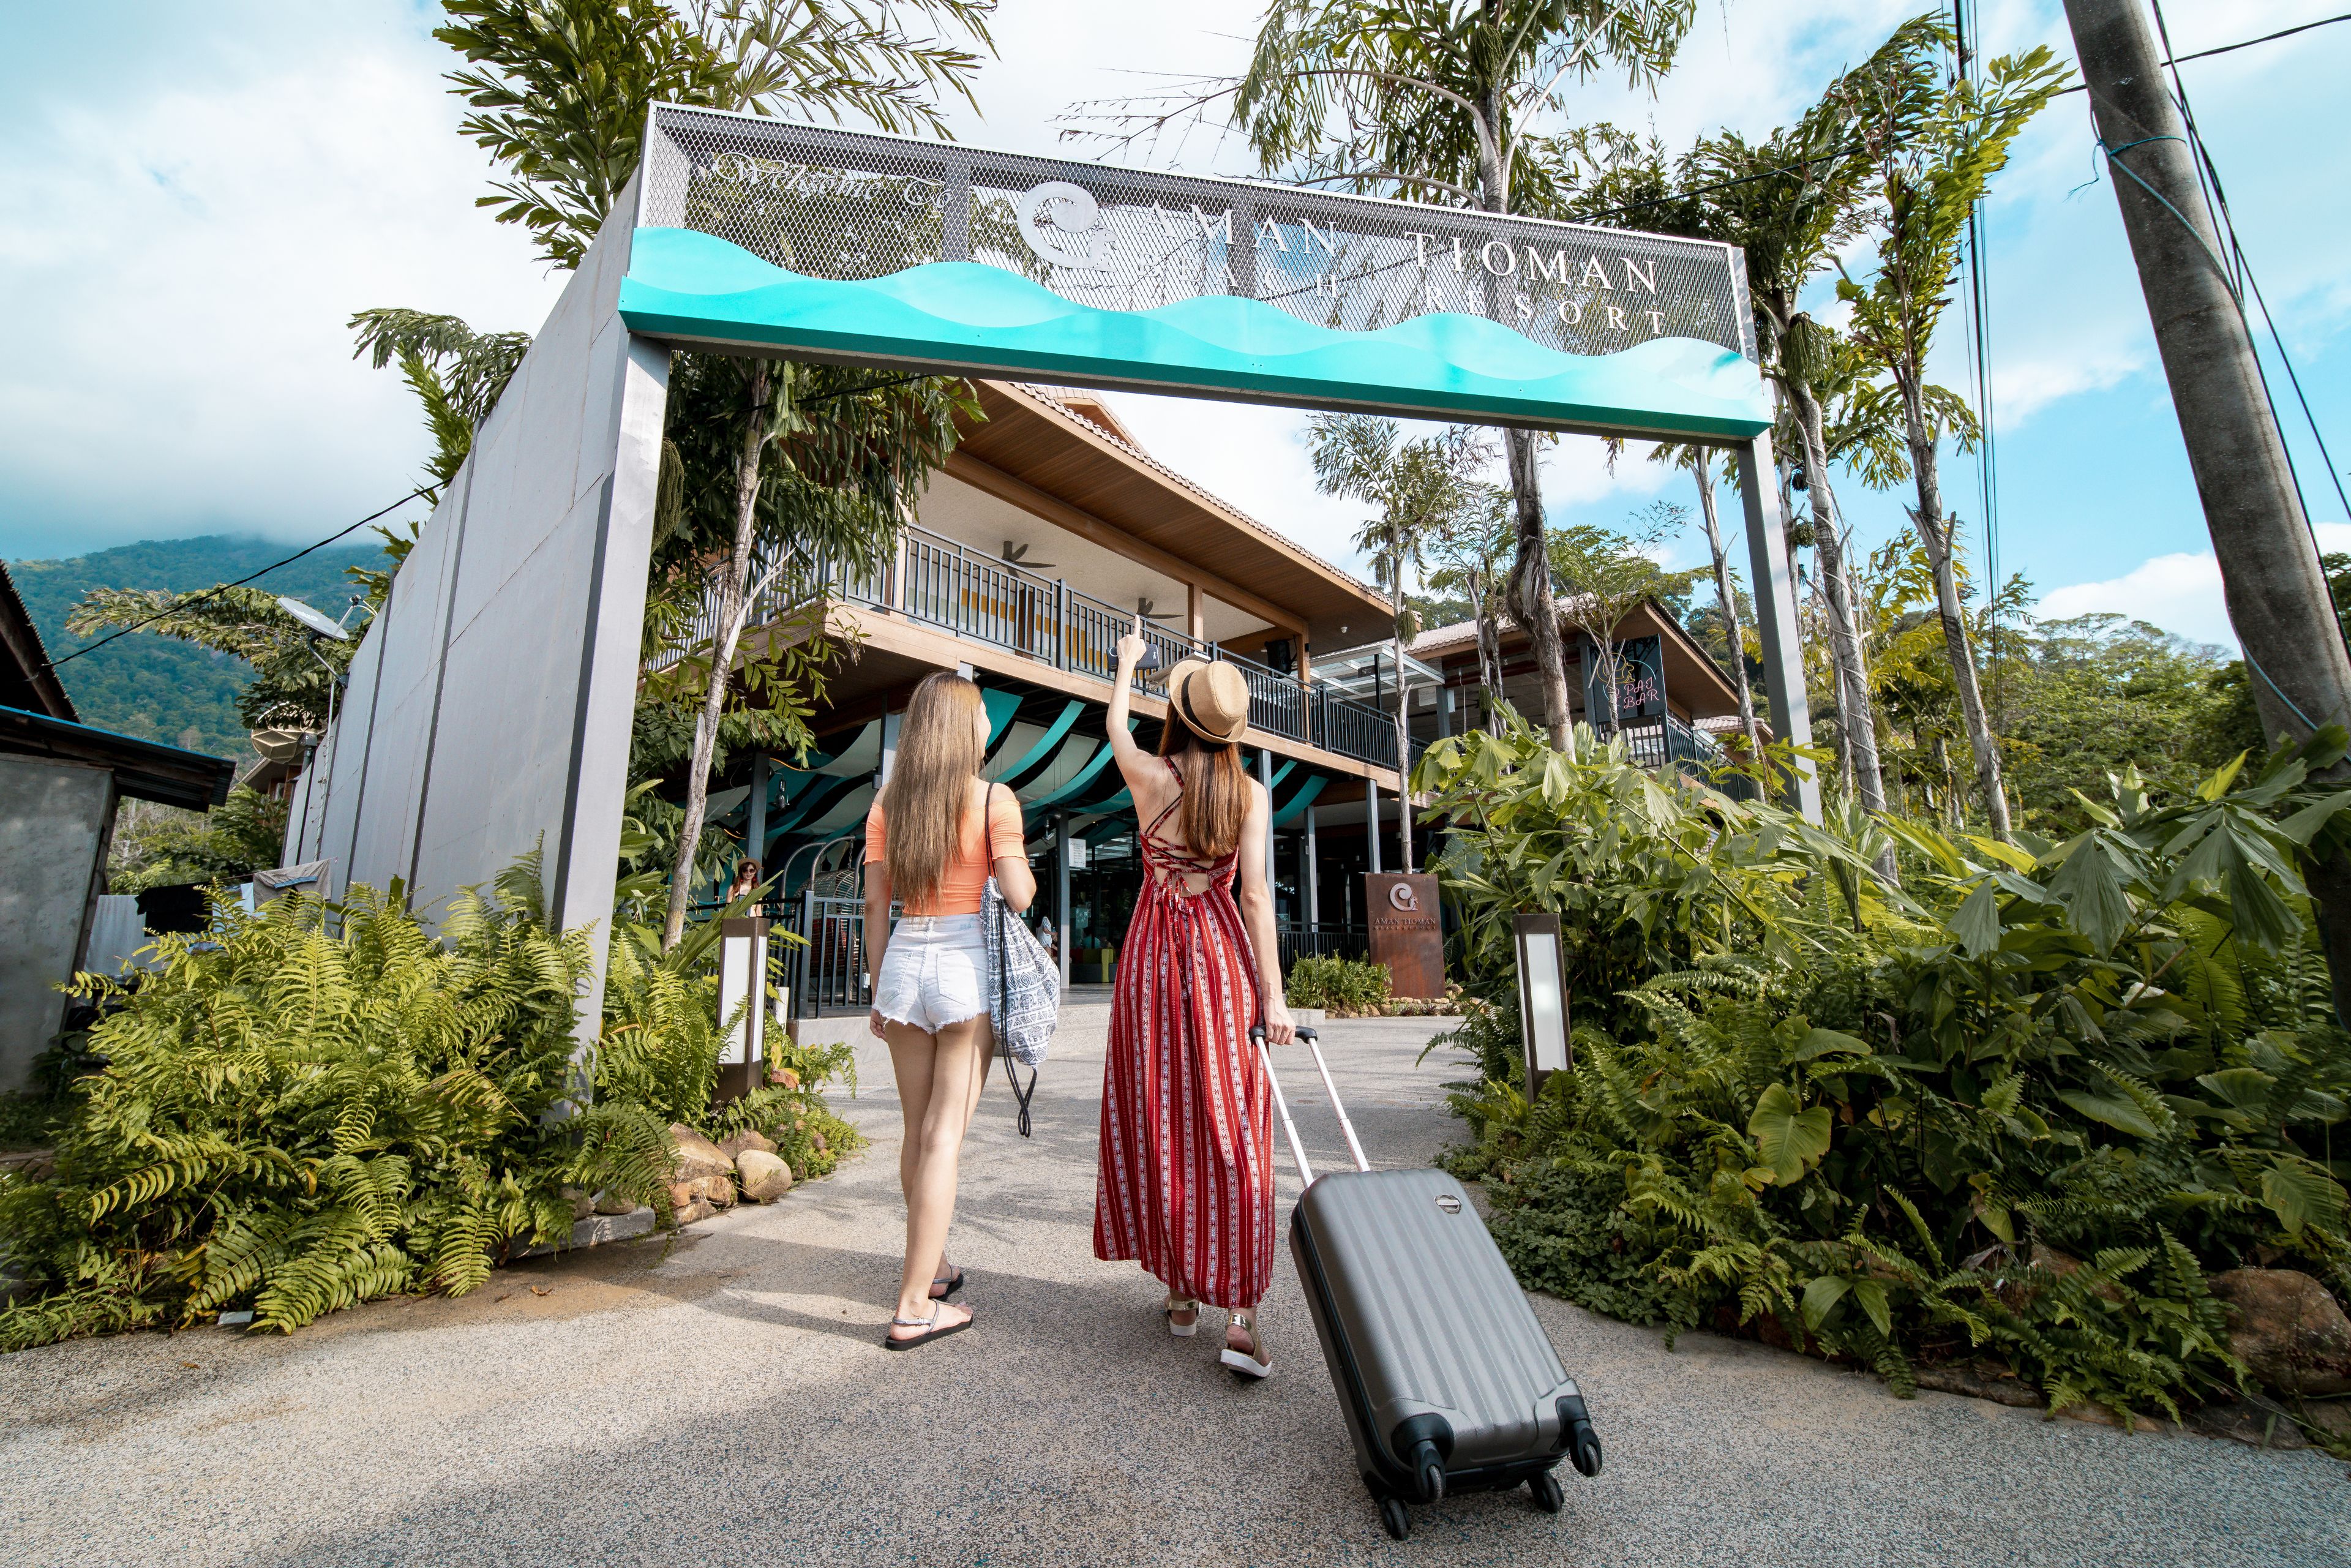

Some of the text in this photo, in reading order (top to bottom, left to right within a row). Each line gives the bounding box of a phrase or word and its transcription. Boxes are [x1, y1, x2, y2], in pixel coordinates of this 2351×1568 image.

[711, 152, 952, 209] Welcome To
[1136, 200, 1657, 295] AMAN TIOMAN
[1137, 251, 1665, 335] BEACH RESORT
[1624, 689, 1660, 709] BAR
